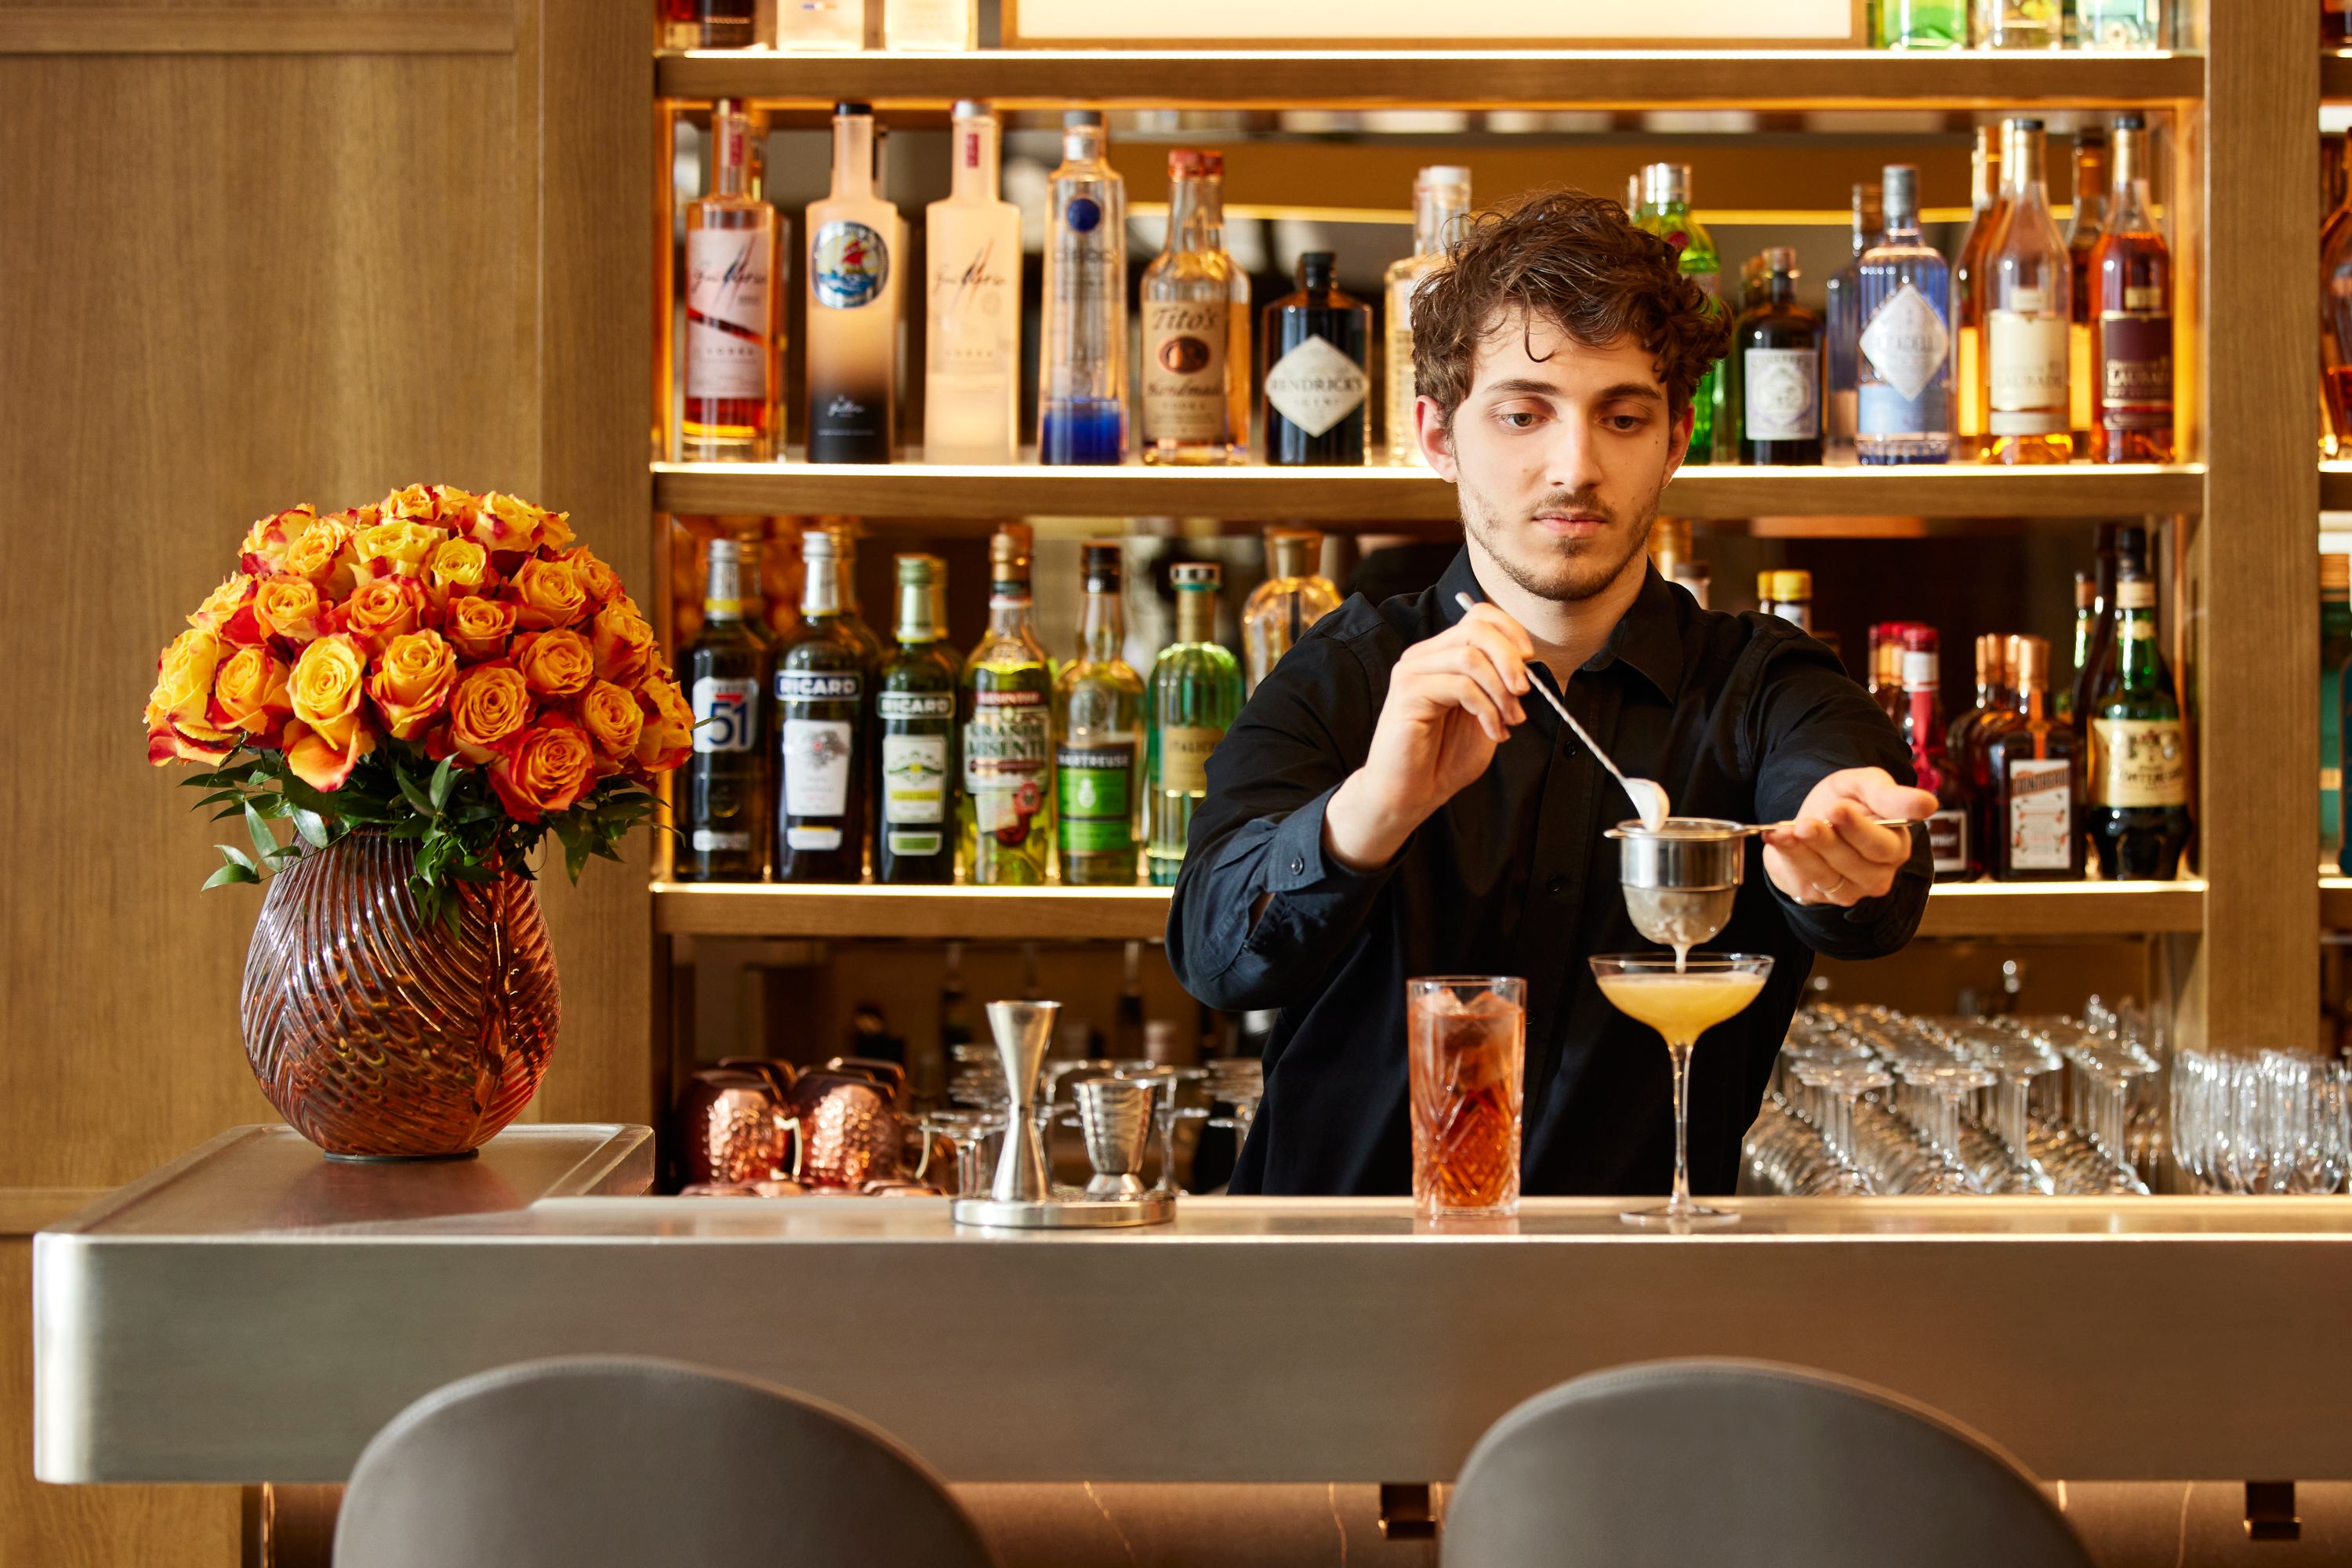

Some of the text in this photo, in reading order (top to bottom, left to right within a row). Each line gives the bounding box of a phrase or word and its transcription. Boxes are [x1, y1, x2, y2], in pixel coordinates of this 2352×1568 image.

[1153, 307, 1216, 330] Tito's
[779, 680, 856, 695] RICARD
[882, 698, 949, 713] RICARD
[708, 702, 746, 746] 51
